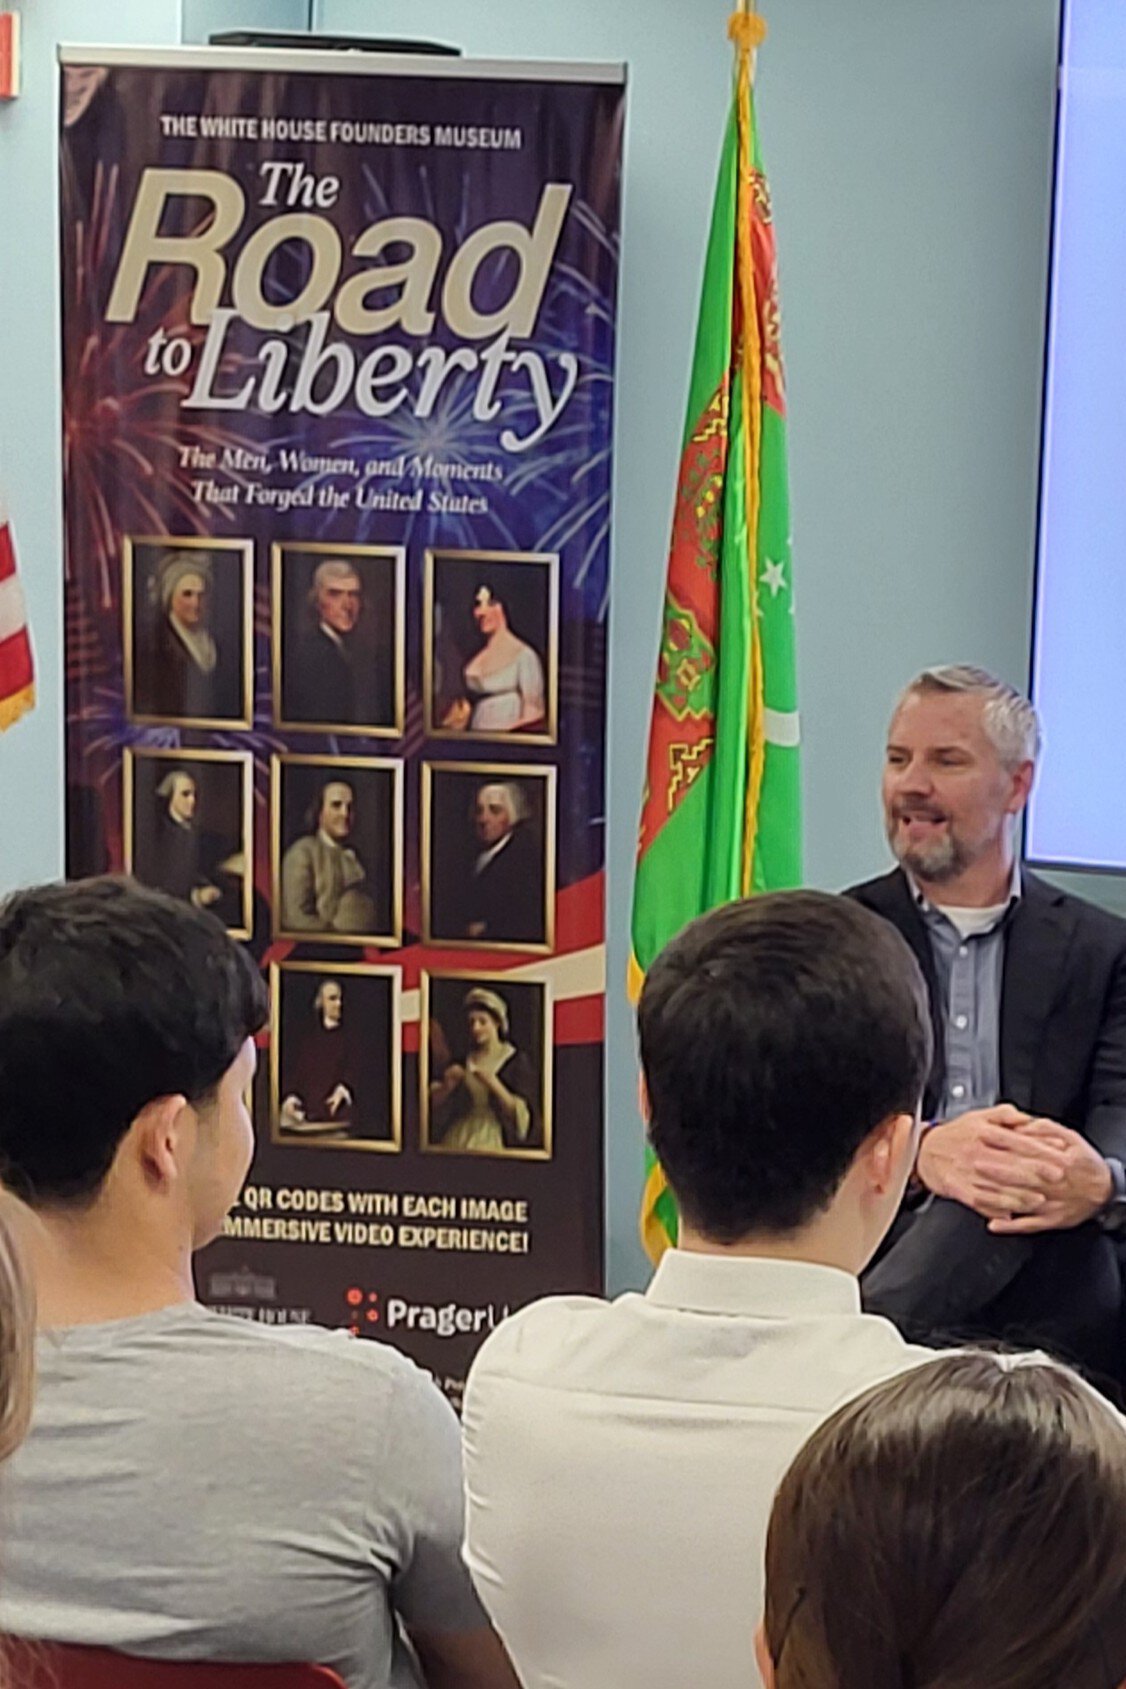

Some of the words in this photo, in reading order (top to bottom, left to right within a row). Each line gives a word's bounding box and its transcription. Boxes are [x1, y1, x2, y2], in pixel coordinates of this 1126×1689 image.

[160, 115, 198, 137] THE
[201, 116, 258, 140] WHITE
[261, 118, 327, 142] HOUSE
[330, 120, 431, 147] FOUNDERS
[434, 125, 522, 149] MUSEUM
[259, 162, 340, 208] The
[105, 167, 573, 340] Road
[144, 328, 193, 376] to
[181, 308, 578, 452] Liberty
[178, 445, 217, 469] The
[219, 449, 272, 475] Men,
[279, 449, 360, 478] Women,
[365, 455, 406, 477] and
[409, 455, 503, 481] Moments
[191, 479, 240, 504] That
[245, 483, 315, 513] Forged
[318, 485, 350, 508] the
[356, 485, 423, 511] United
[427, 490, 489, 514] States
[244, 1186, 273, 1211] QR
[276, 1188, 344, 1213] CODES
[347, 1192, 398, 1216] WITH
[402, 1195, 456, 1219] EACH
[460, 1197, 528, 1223] IMAGE
[224, 1216, 332, 1243] MMERSIVE
[334, 1221, 394, 1246] VIDEO
[398, 1224, 529, 1254] EXPERIENCE!
